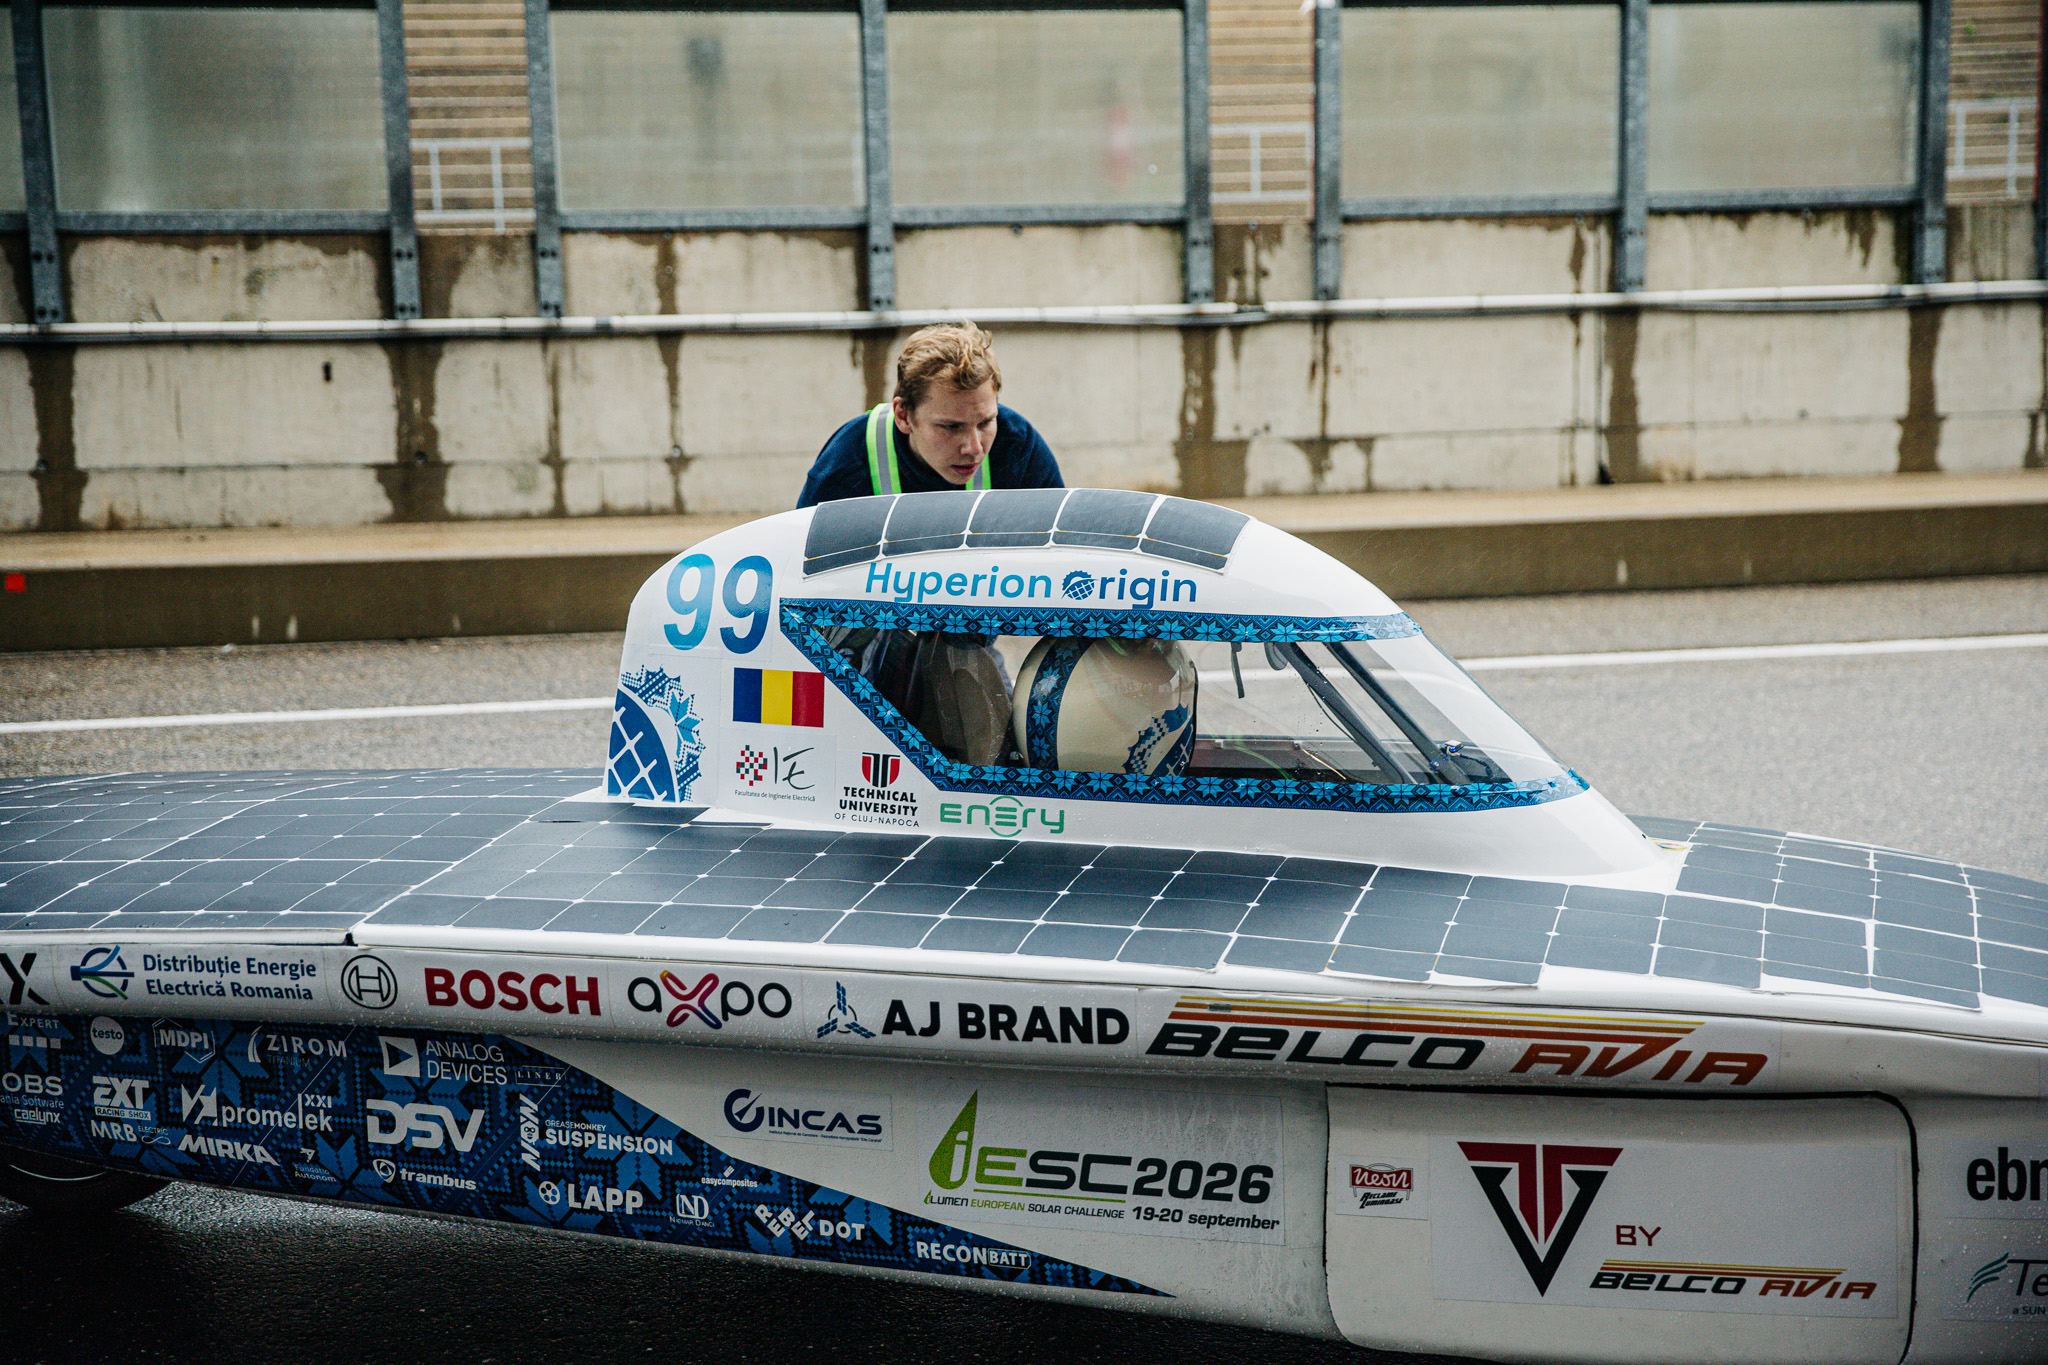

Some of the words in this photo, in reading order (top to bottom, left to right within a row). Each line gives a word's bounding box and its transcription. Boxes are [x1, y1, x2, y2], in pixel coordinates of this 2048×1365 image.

[865, 562, 1052, 603] Hyperion
[663, 553, 773, 654] 99
[843, 786, 917, 803] TECHNICAL
[834, 812, 846, 820] OF
[851, 814, 920, 827] CLUJ-NAPOCA
[839, 799, 918, 817] UNIVERSITY
[143, 954, 241, 978] Distribuție
[246, 957, 317, 980] Energie
[146, 979, 226, 997] Electrică
[230, 982, 313, 1001] Romania
[424, 967, 602, 1016] BOSCH
[627, 969, 793, 1029] axpo
[92, 1028, 123, 1040] testo
[881, 999, 940, 1036] AJ
[958, 1002, 1130, 1045] BRAND
[159, 1029, 210, 1050] MDPI
[265, 1034, 348, 1058] ZIROM
[426, 1040, 505, 1063] ANALOG
[1145, 1022, 1485, 1071] BELCO
[1508, 1035, 1769, 1086] AVIA
[2, 1072, 63, 1096] OBS
[427, 1060, 508, 1086] DEVICES
[517, 1070, 563, 1081] LINER
[93, 1075, 150, 1110] EXT
[304, 1094, 333, 1108] XXI
[14, 1107, 61, 1126] caelynx
[96, 1107, 126, 1118] RACING
[128, 1110, 150, 1120] SHOX
[222, 1093, 333, 1132] promelek
[768, 1106, 882, 1136] INCAS
[91, 1119, 138, 1143] MRB
[366, 1099, 485, 1152] DSV
[545, 1119, 607, 1132] GREASEMONKEY
[177, 1134, 280, 1167] MIRKA
[545, 1128, 673, 1156] SUSPENSION
[400, 1167, 477, 1191] trambus
[701, 1176, 758, 1188] easycomposites
[1353, 1168, 1409, 1188] neon
[568, 1183, 644, 1215] LAPP
[970, 1198, 1025, 1211] EUROPEAN
[1028, 1203, 1062, 1214] SOLAR
[1064, 1206, 1125, 1219] CHALLENGE
[1132, 1206, 1184, 1223] 19-20
[1188, 1214, 1280, 1230] september
[1616, 1224, 1662, 1247] BY
[1589, 1271, 1747, 1295] BELCO
[1758, 1276, 1878, 1300] AVIA
[2022, 1306, 2046, 1315] SUN
